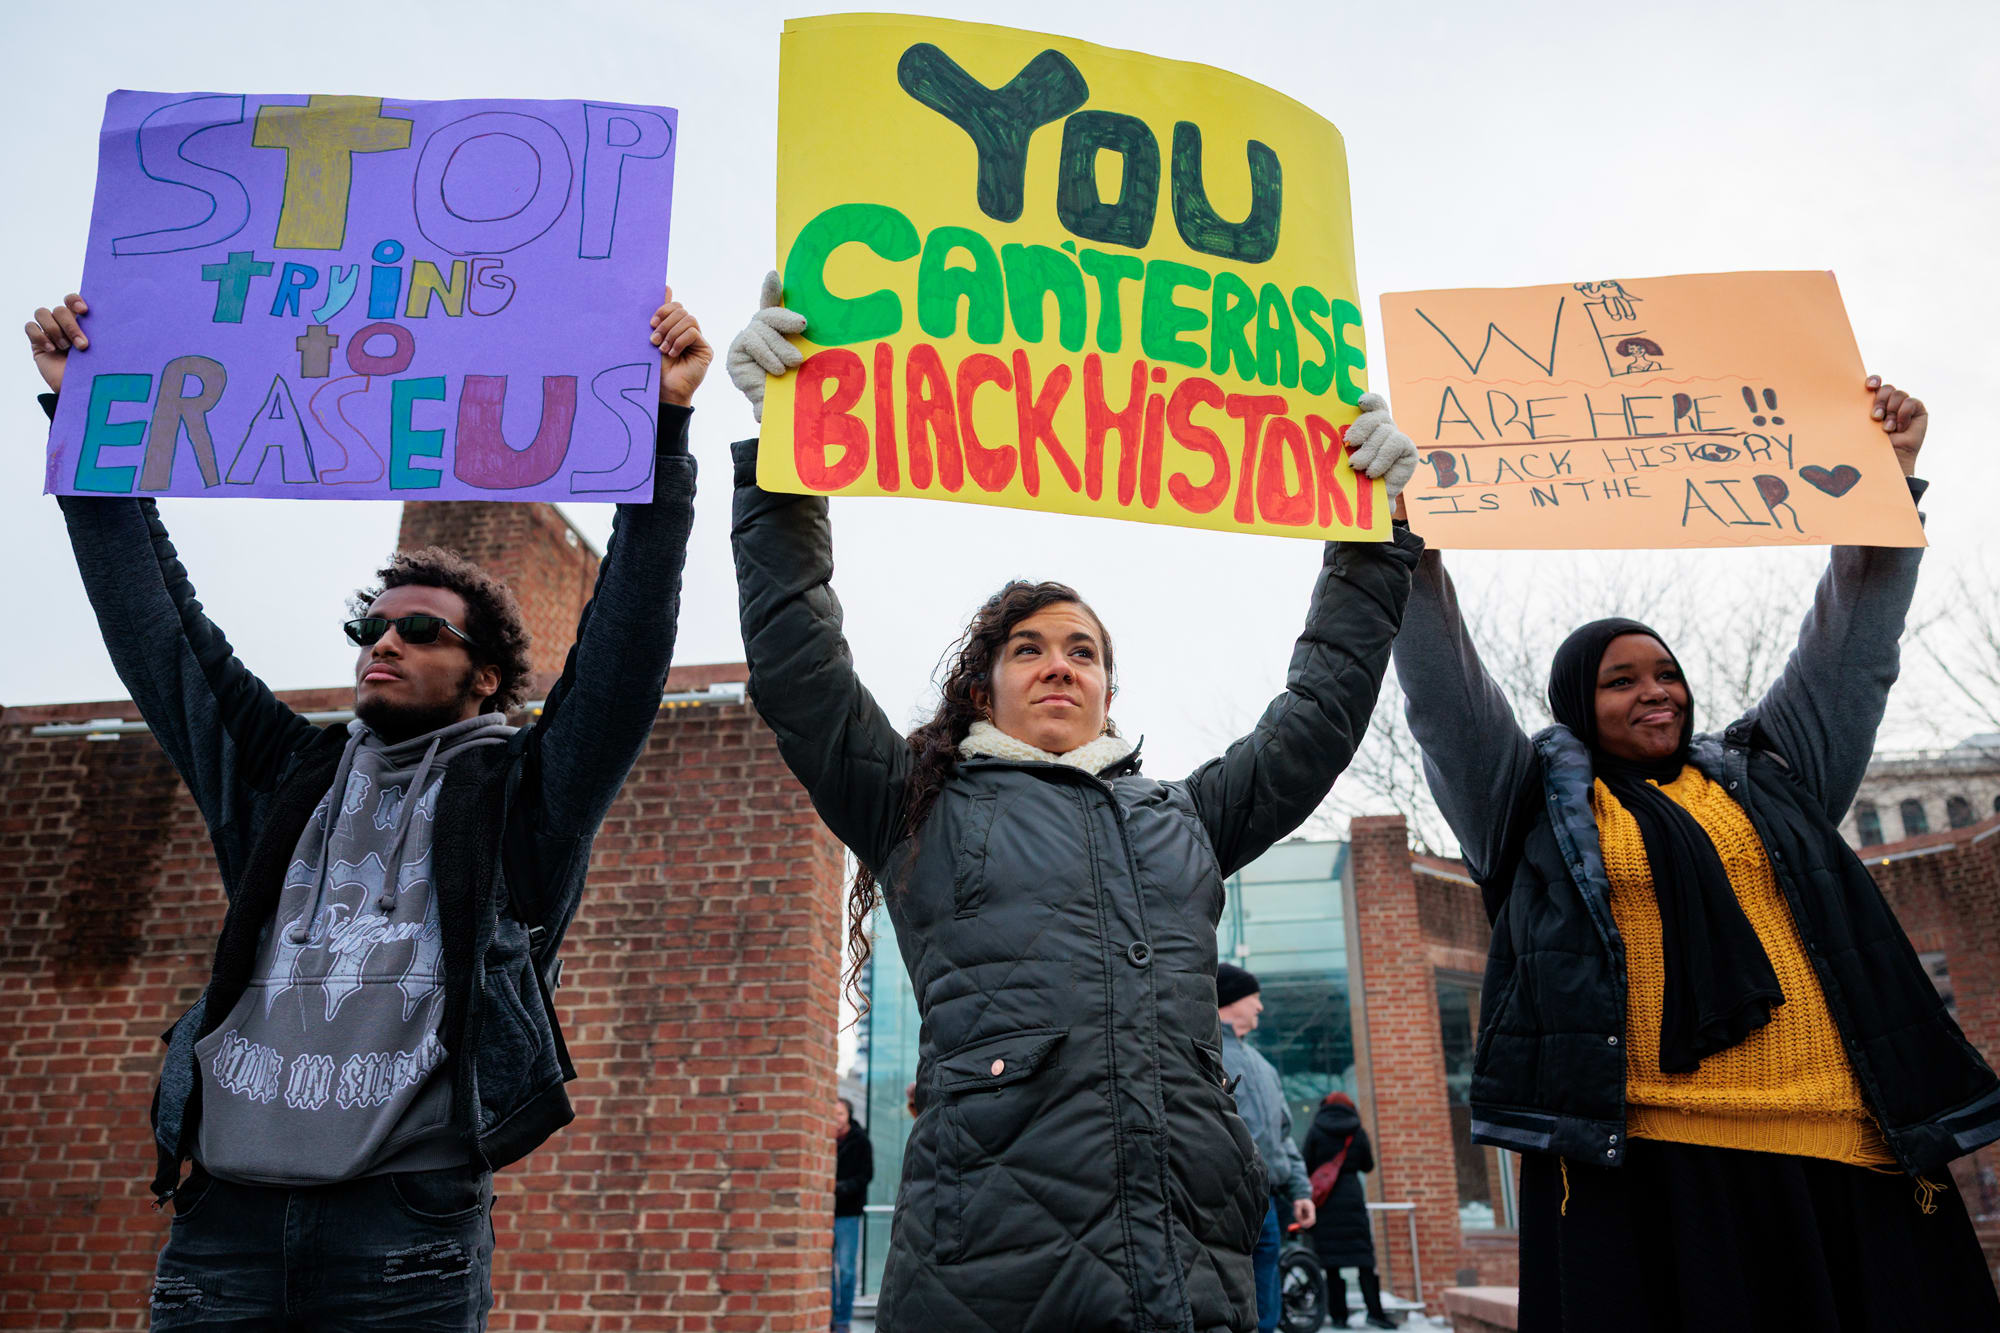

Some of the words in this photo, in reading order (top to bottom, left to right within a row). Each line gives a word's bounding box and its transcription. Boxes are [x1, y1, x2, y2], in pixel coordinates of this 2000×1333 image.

[112, 94, 673, 259] STOP
[897, 42, 1282, 264] YOU
[1141, 259, 1366, 407] ERASE
[1415, 296, 1673, 378] WE
[73, 355, 447, 493] ERASE
[453, 363, 654, 494] US
[1435, 386, 1571, 440] ARE
[1415, 493, 1500, 515] IS
[1530, 483, 1560, 507] IN
[1562, 476, 1652, 502] THE
[1681, 474, 1804, 533] AIR
[1419, 449, 1573, 488] BLACK
[285, 1054, 336, 1110] IN
